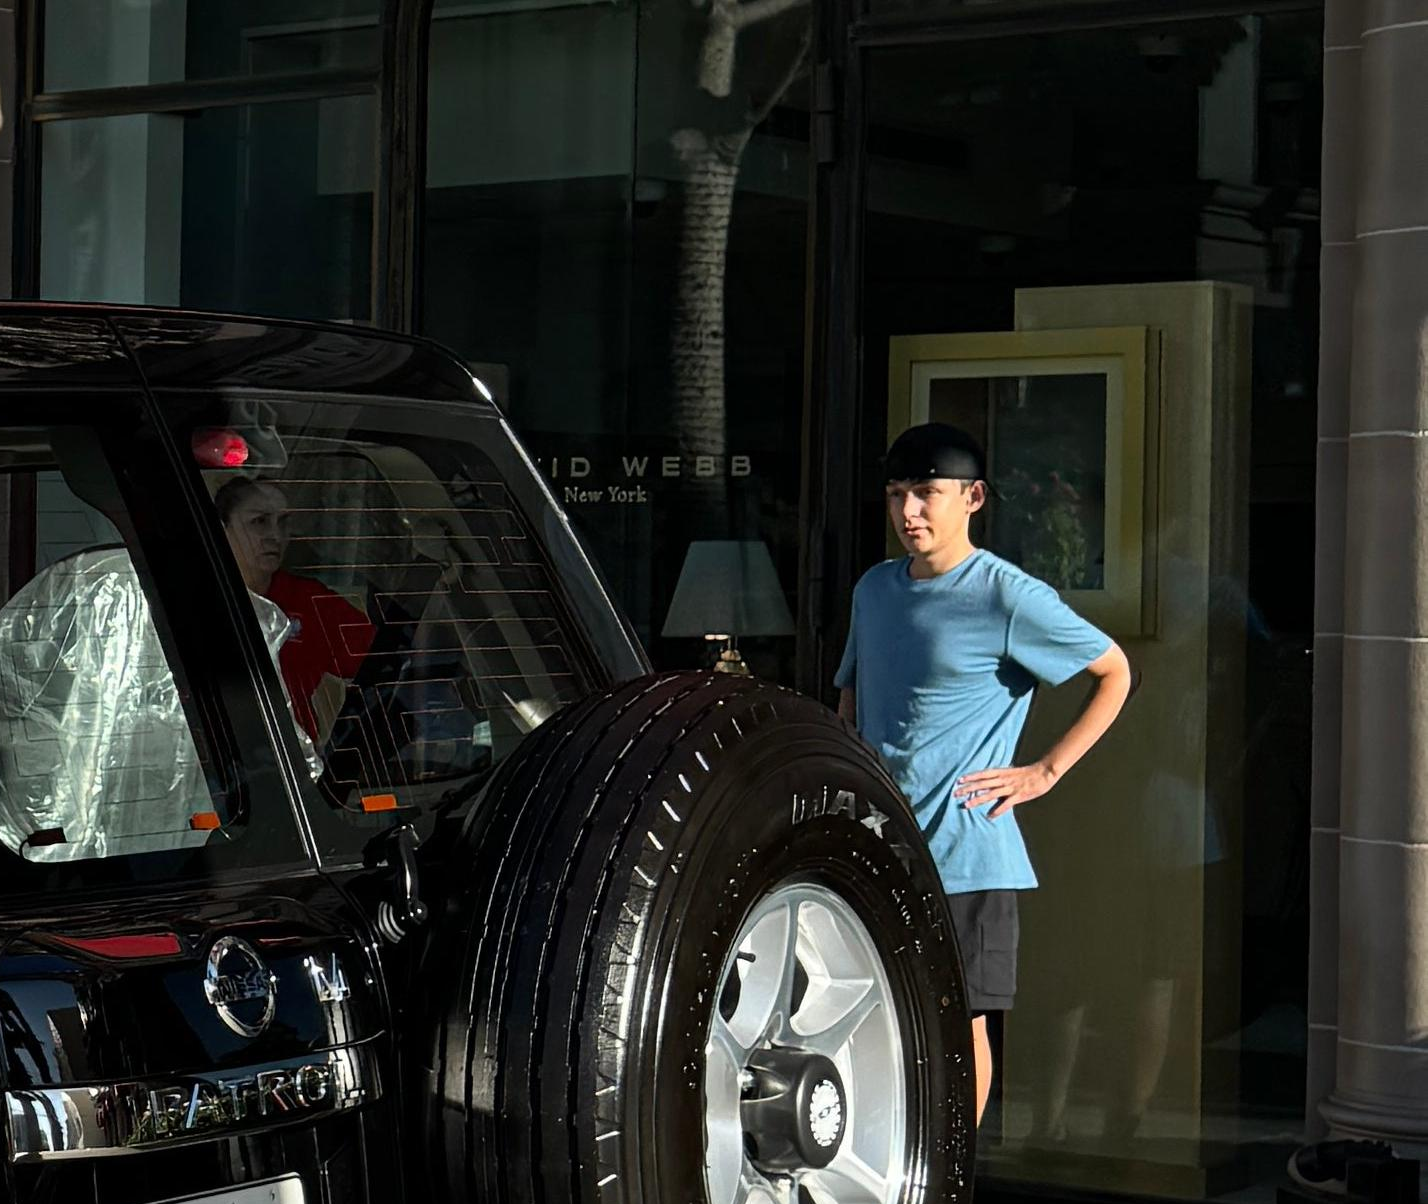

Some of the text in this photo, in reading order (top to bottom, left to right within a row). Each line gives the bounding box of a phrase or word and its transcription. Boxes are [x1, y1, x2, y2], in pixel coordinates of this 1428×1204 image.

[622, 456, 752, 478] WEBB
[564, 485, 647, 503] New York
[149, 1060, 366, 1135] PATROL
